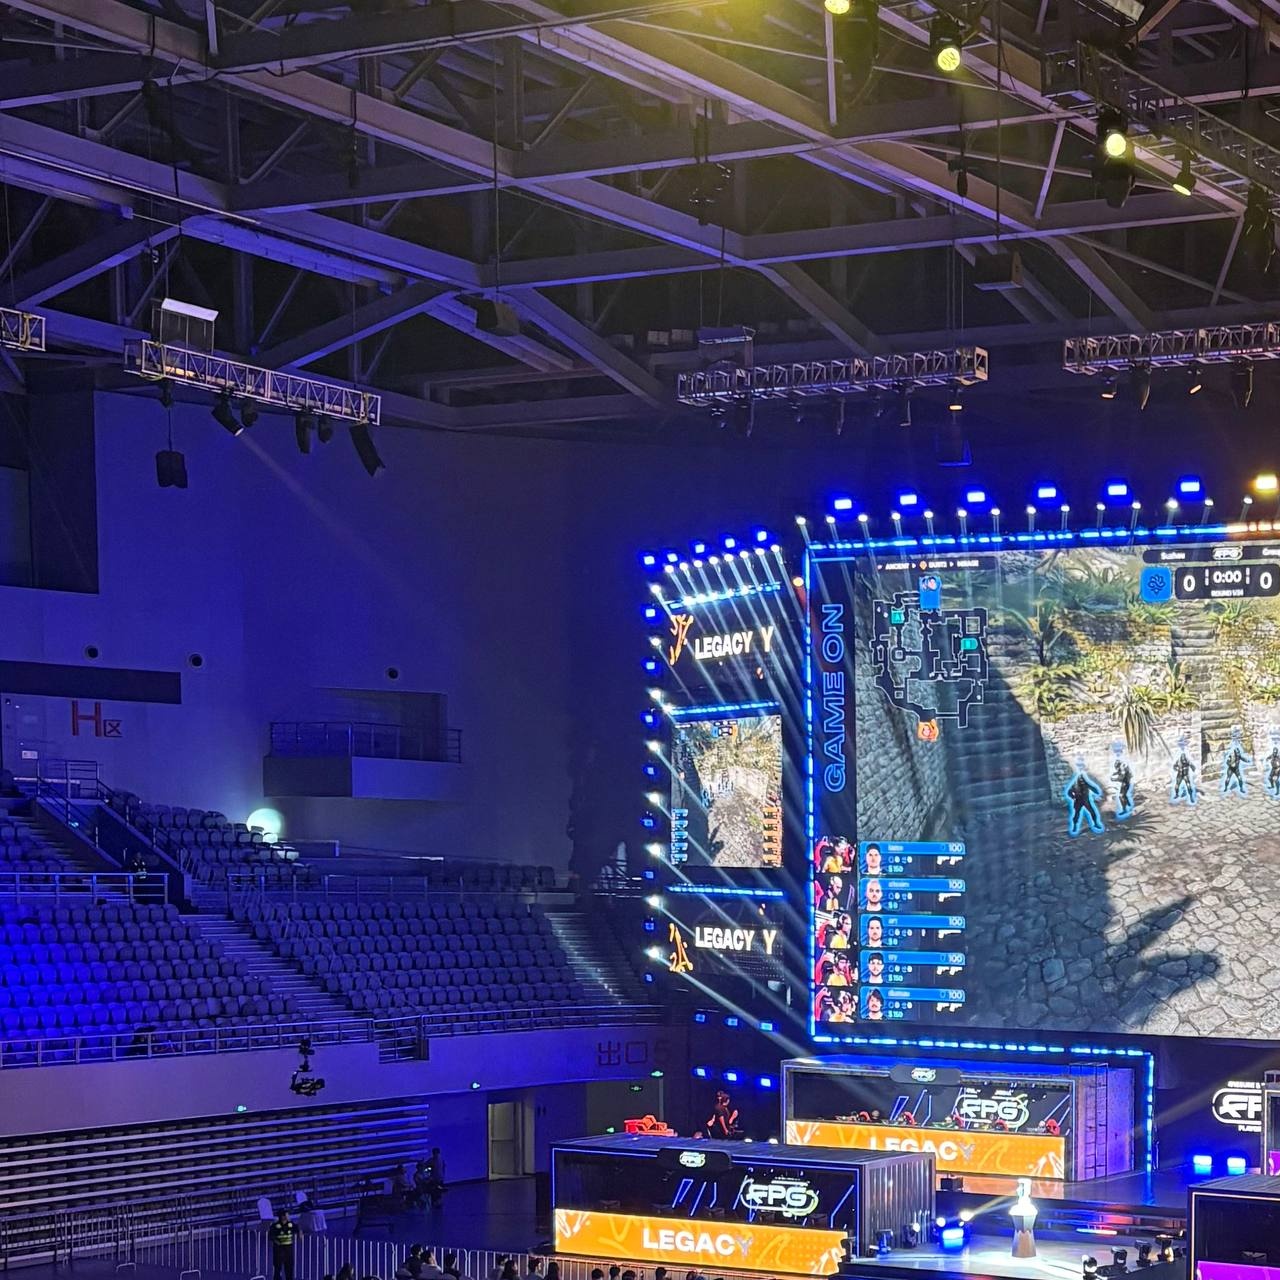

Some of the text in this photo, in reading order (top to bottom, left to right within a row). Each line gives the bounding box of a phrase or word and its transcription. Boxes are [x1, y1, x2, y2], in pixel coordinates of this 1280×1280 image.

[1183, 575, 1196, 592] 0
[1213, 570, 1242, 583] 0:00
[1259, 571, 1272, 589] 0
[694, 630, 753, 660] LEGACY
[822, 603, 846, 793] GAME ON
[949, 843, 962, 851] 100
[949, 880, 962, 888] 100
[949, 917, 962, 925] 100
[695, 926, 755, 951] LEGACY
[949, 954, 962, 962] 100
[949, 991, 962, 999] 100
[870, 1136, 976, 1160] LEGACY
[642, 1227, 753, 1257] LEGACY
